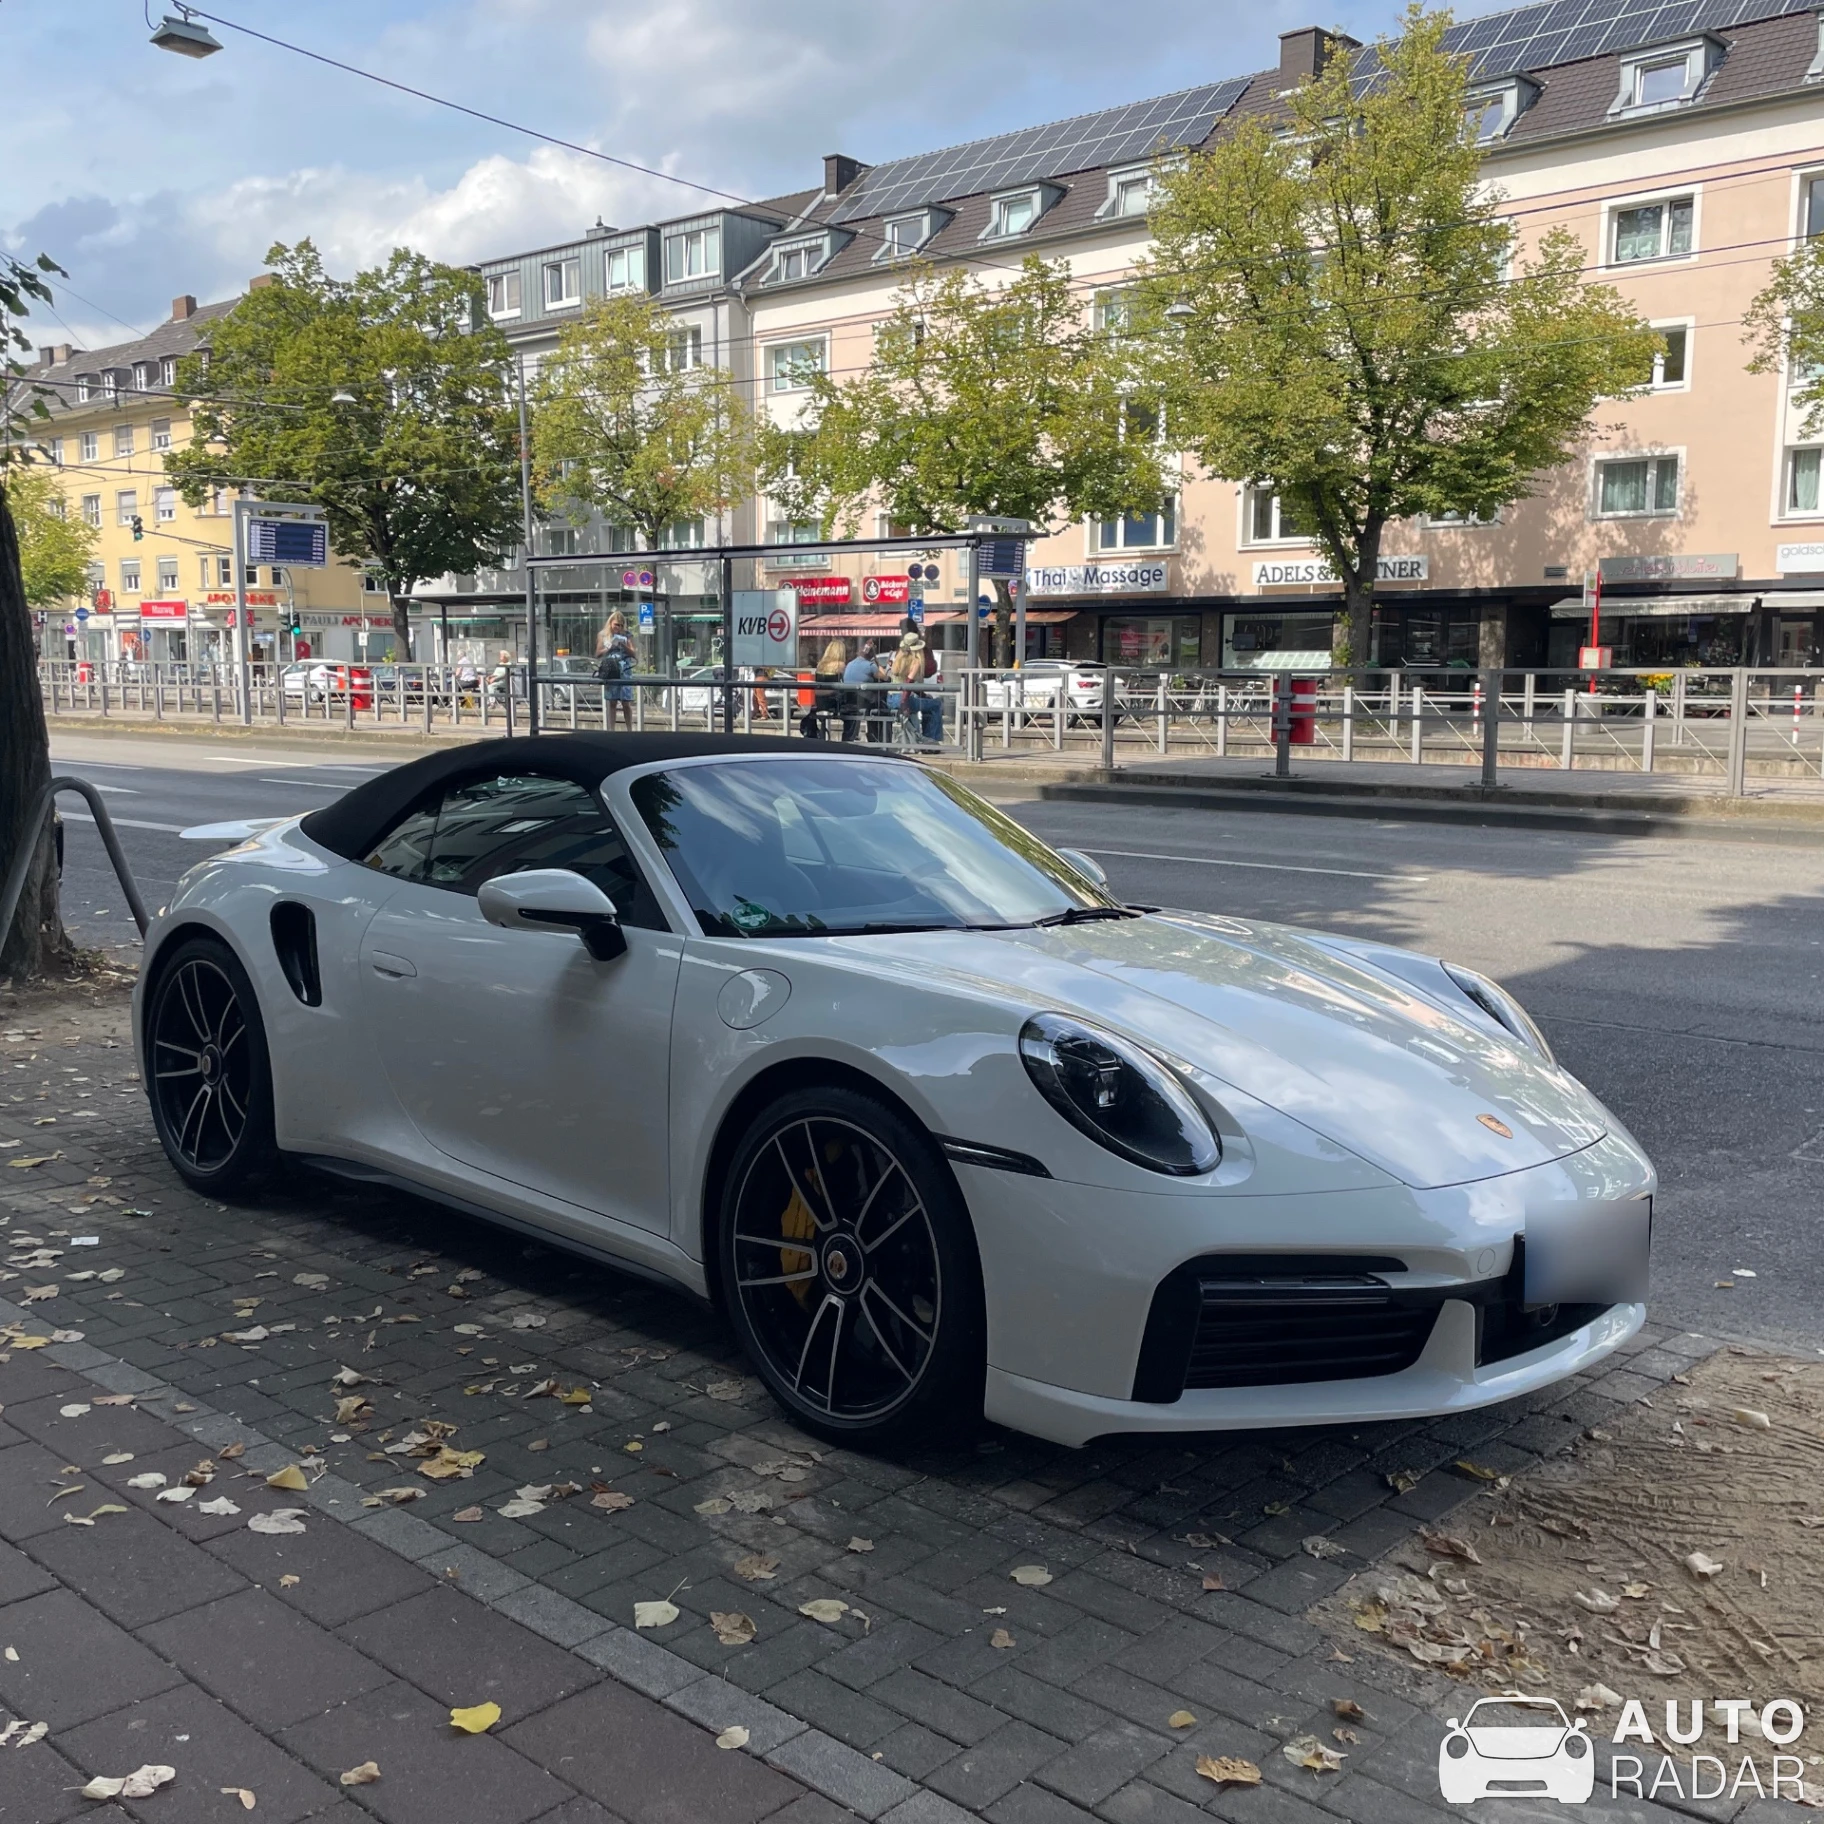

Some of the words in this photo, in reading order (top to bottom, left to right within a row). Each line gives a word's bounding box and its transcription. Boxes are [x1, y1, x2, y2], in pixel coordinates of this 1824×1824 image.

[1781, 545, 1824, 559] goldsc
[1034, 569, 1066, 586] Thai
[1084, 568, 1163, 587] Massage
[1256, 564, 1315, 584] ADELS
[641, 604, 648, 614] P
[38, 611, 48, 622] H
[302, 615, 339, 626] PAULI
[738, 616, 768, 635] KVB
